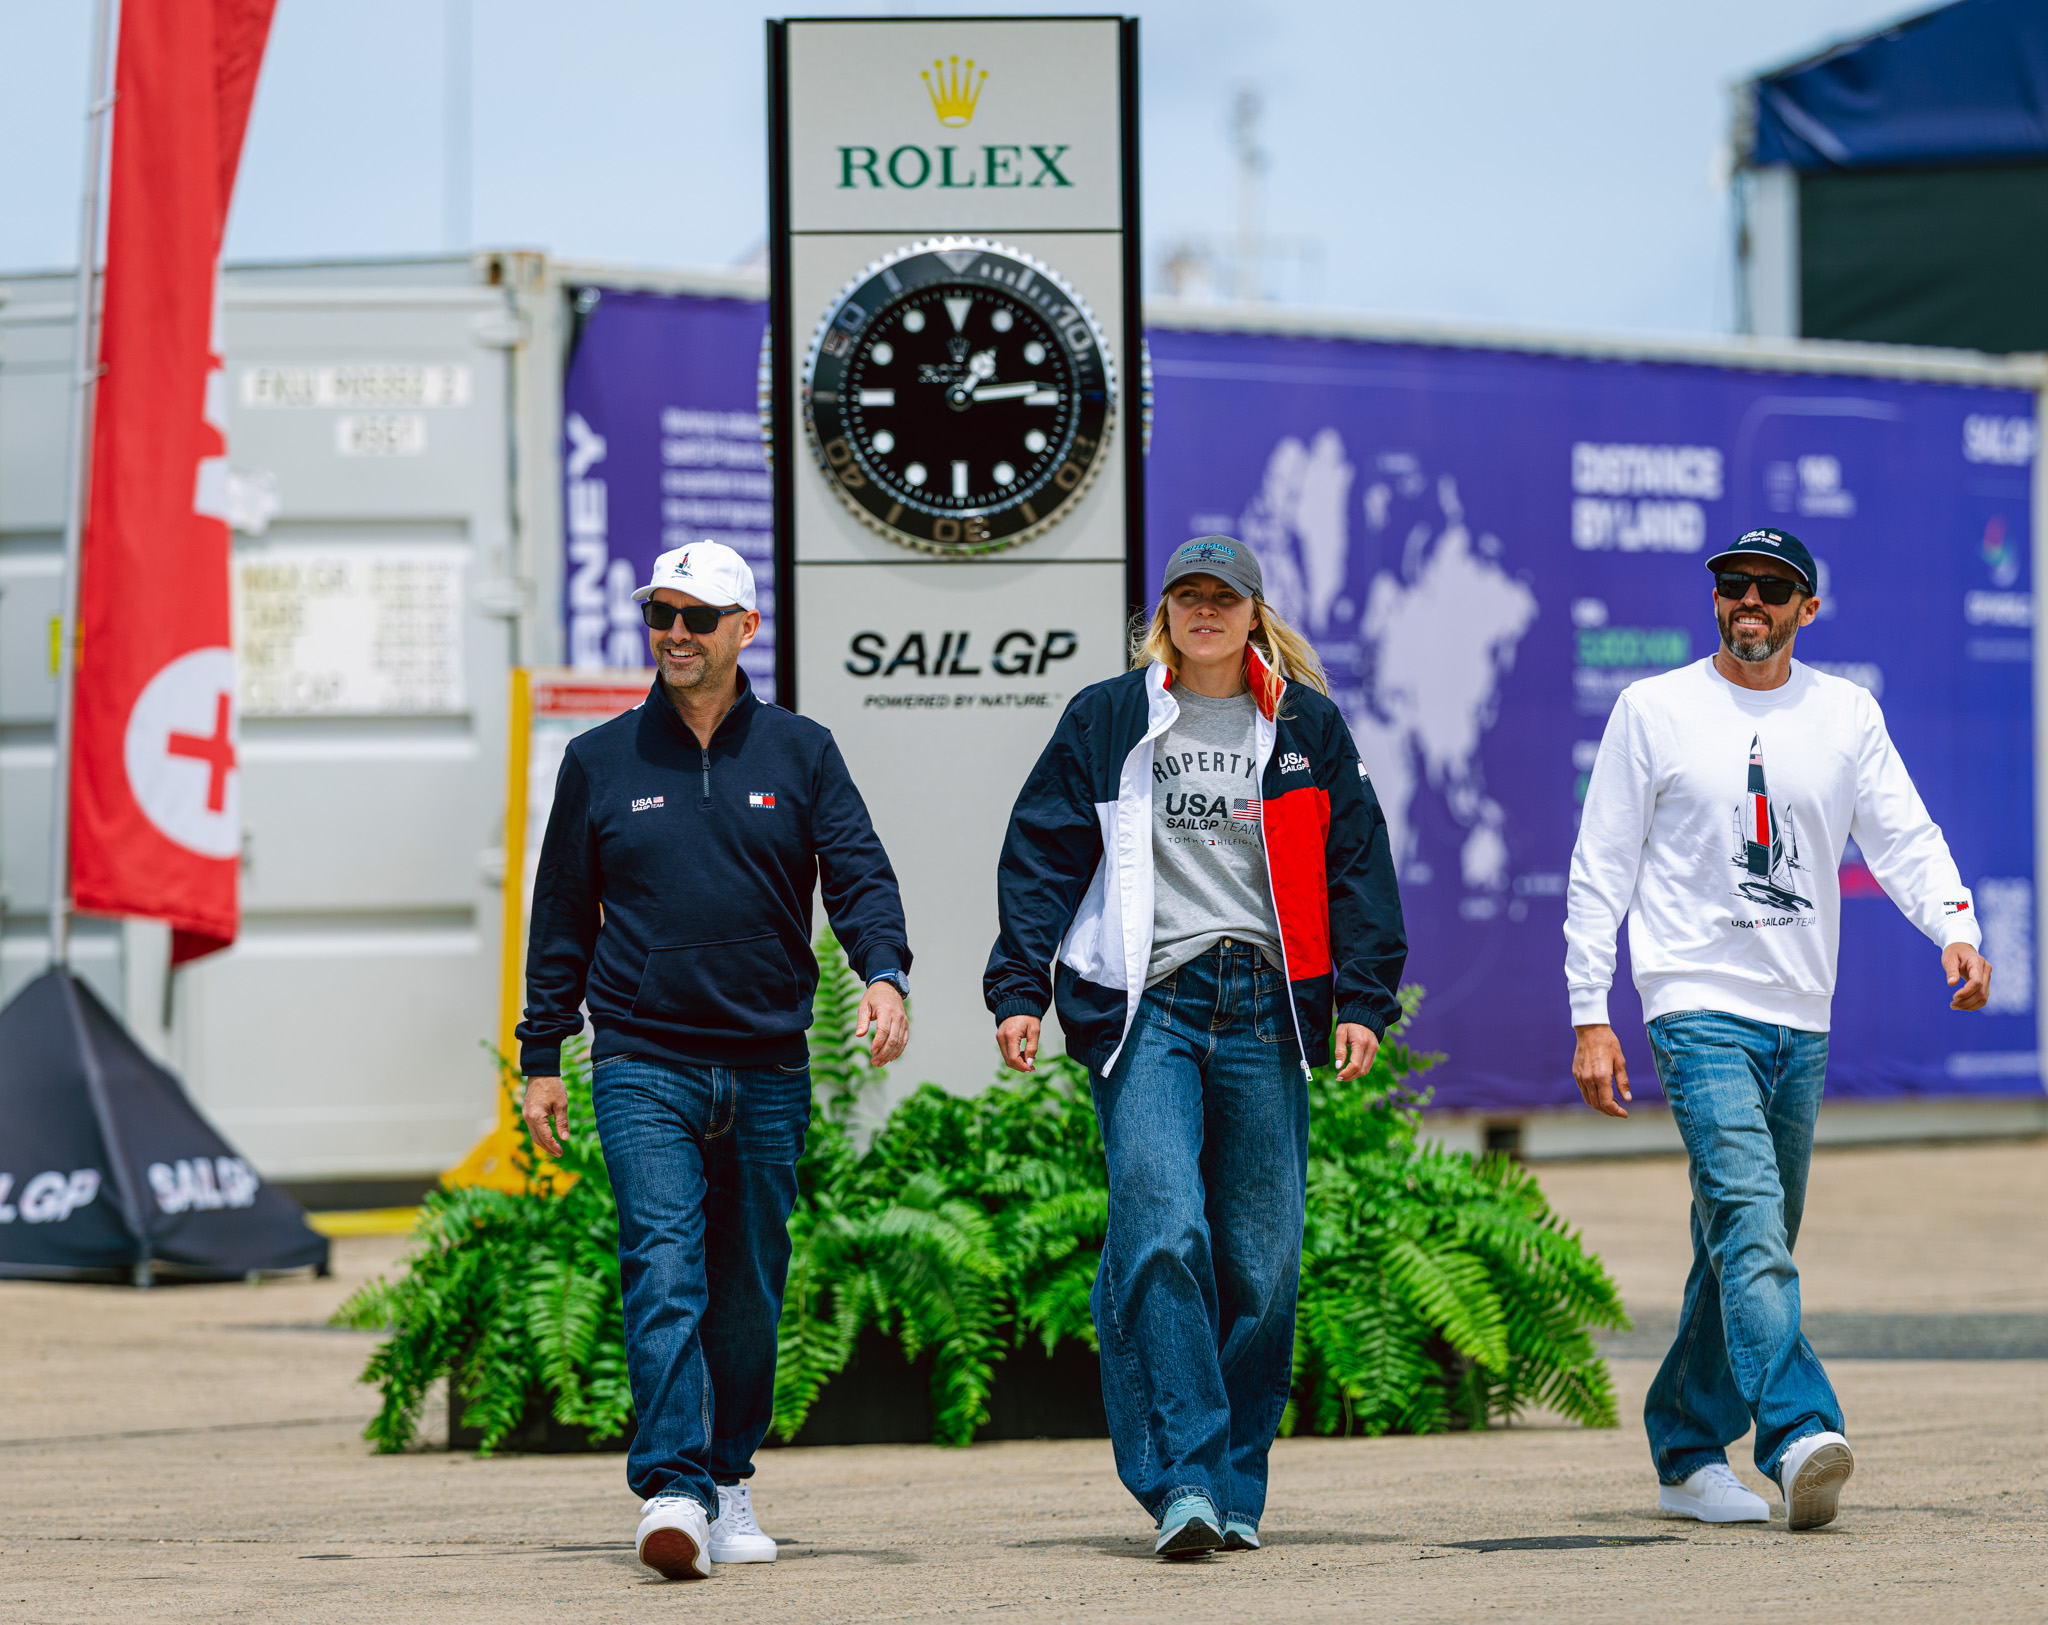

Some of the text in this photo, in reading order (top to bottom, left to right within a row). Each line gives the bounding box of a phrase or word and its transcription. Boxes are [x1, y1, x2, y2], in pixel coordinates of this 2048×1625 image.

[836, 145, 1075, 189] ROLEX
[1057, 307, 1093, 354] 10
[1741, 530, 1765, 541] USA
[864, 692, 950, 709] POWERED
[953, 692, 977, 708] BY
[632, 797, 653, 808] USA
[1166, 793, 1228, 818] USA
[1166, 818, 1219, 831] SAILGP
[1168, 837, 1205, 845] TOMMY
[1731, 920, 1754, 928] USA
[1762, 917, 1793, 926] SAILGP
